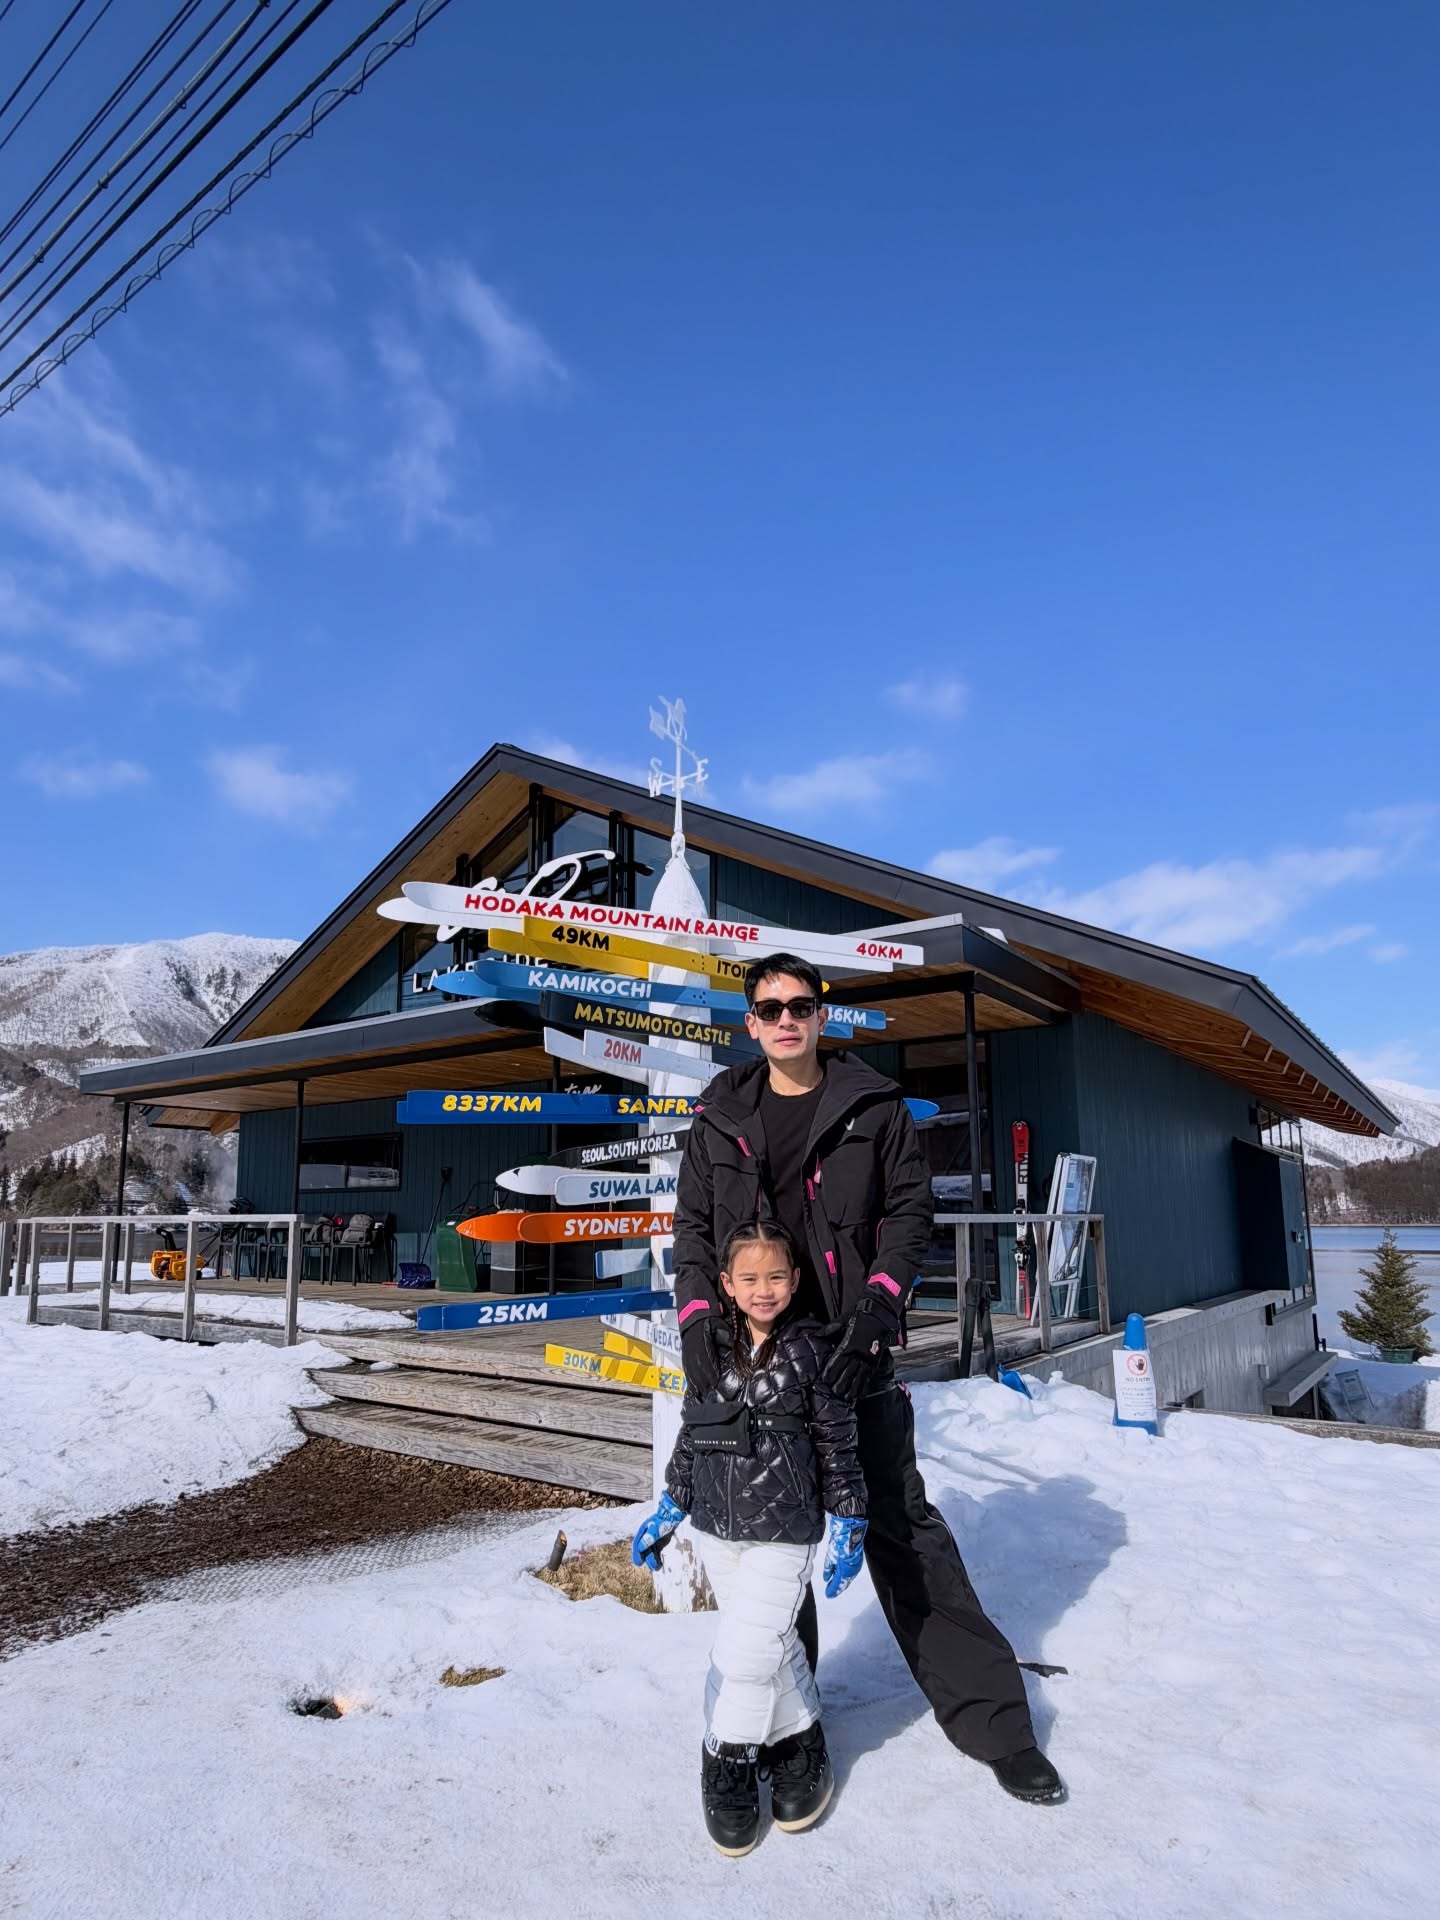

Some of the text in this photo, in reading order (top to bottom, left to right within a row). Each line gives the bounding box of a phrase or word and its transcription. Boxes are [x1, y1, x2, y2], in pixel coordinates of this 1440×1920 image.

[464, 893, 902, 960] HODAKA MOUNTAIN RANGE 40KM
[552, 925, 609, 951] 49KM
[528, 970, 651, 999] KAMIKOCHI
[574, 1002, 731, 1046] MATSUMOTO CASTLE
[603, 1038, 641, 1064] 20KM
[442, 1094, 542, 1113] 8337KM
[641, 1133, 677, 1154] KOREA
[589, 1179, 641, 1198] SUWA
[477, 1302, 548, 1325] 25KM
[653, 1327, 673, 1350] UEDA
[563, 1352, 601, 1373] 30KM
